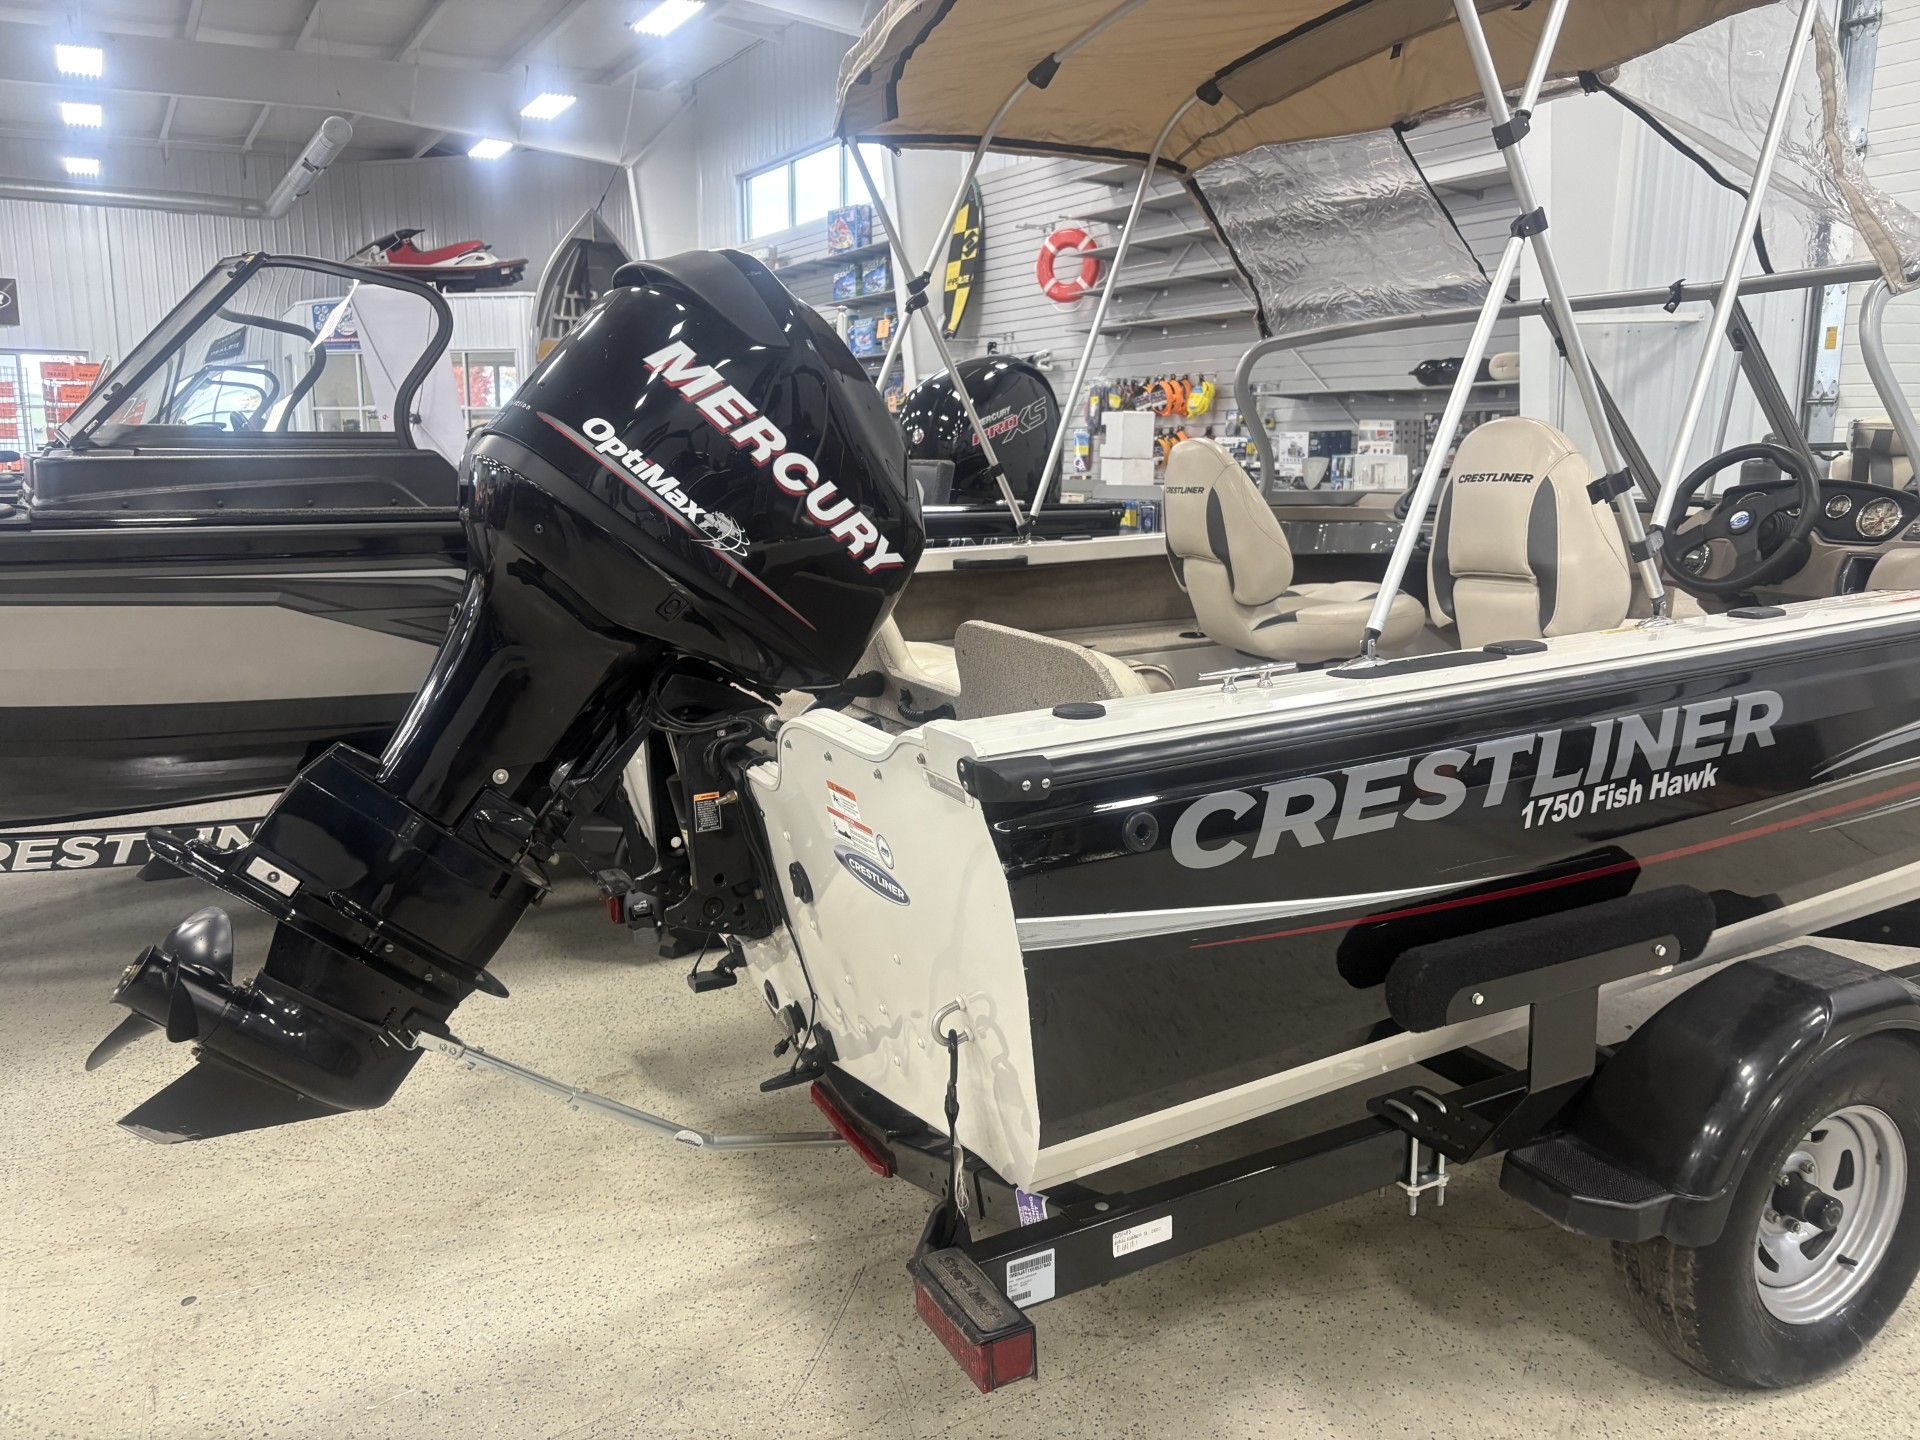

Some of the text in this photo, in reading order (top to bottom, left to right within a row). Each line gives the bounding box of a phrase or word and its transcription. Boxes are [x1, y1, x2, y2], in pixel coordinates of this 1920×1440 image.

[582, 417, 707, 524] OptiMax
[643, 340, 905, 574] MERCURY
[1458, 472, 1534, 484] CRESTLINER
[1170, 690, 1784, 869] CRESTLINER
[1521, 763, 1717, 831] 1750 Fish Hawk
[848, 858, 905, 901] CRESTLINER
